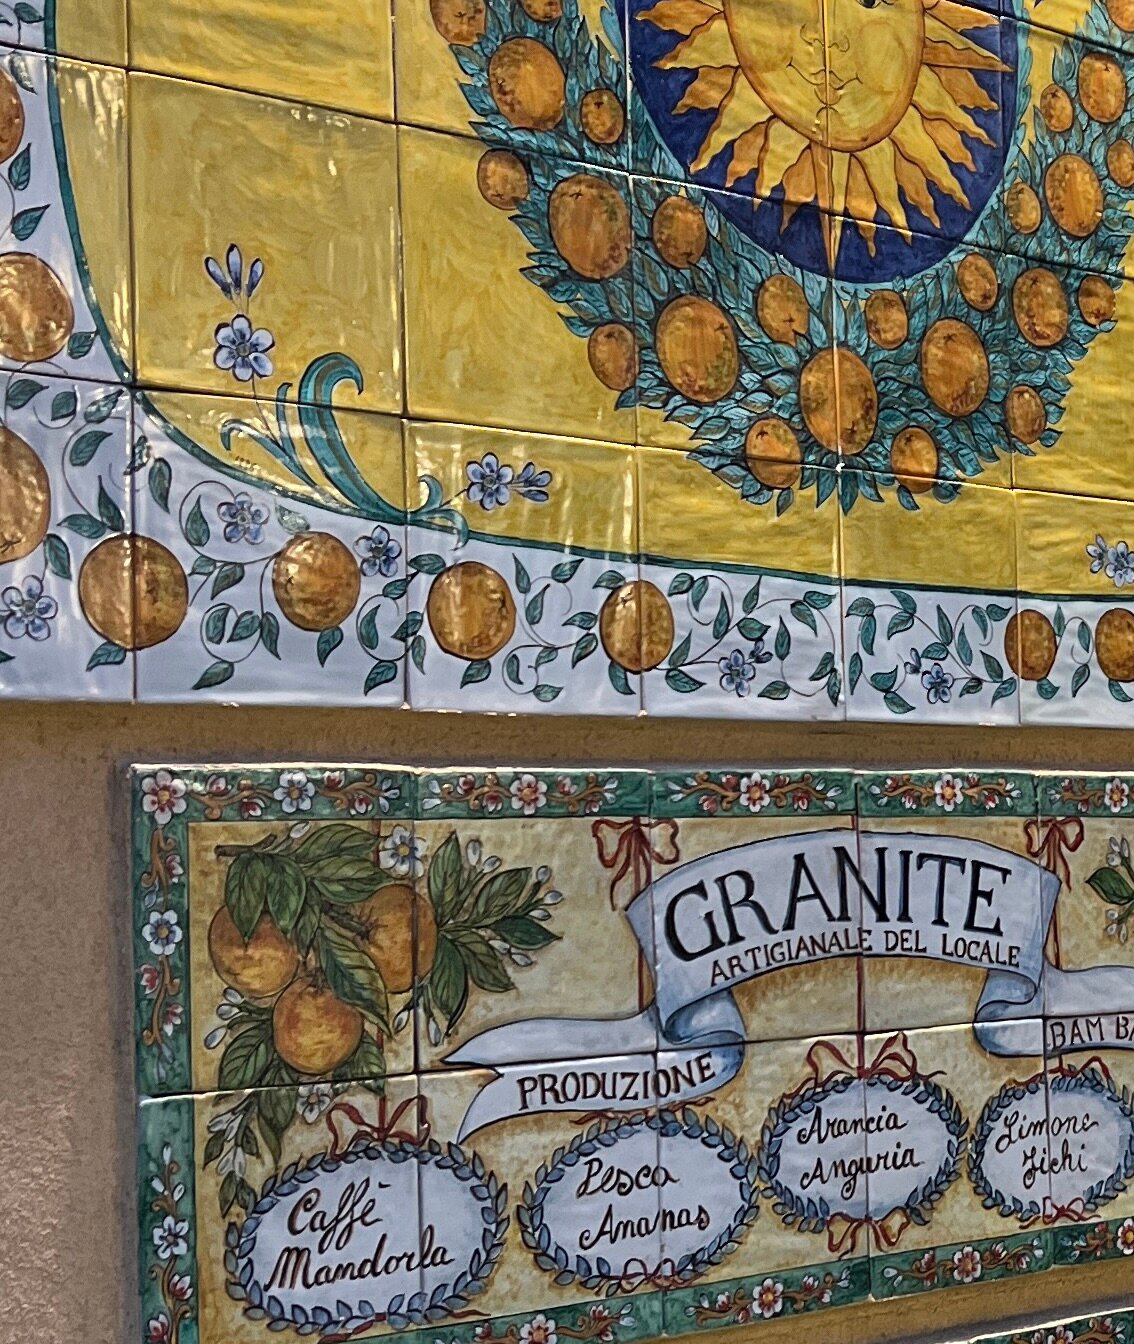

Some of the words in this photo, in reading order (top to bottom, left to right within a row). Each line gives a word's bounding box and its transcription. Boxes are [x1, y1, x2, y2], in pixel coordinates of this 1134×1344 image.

[664, 846, 1013, 962] GRANITE
[709, 927, 874, 988] ARTIGIANALE
[883, 929, 928, 955] DEL
[941, 932, 1021, 969] LOCALE
[1050, 1017, 1107, 1049] BAM
[517, 1052, 718, 1112] PRODUZIONE
[797, 1104, 909, 1145] Arancia
[994, 1109, 1099, 1154] Limone
[577, 1157, 681, 1198] Pesca
[800, 1142, 925, 1202] Anguria
[1021, 1137, 1089, 1190] Fichi
[287, 1180, 391, 1251] Caffè
[578, 1202, 711, 1251] Ananas
[264, 1224, 455, 1293] Mandorla
